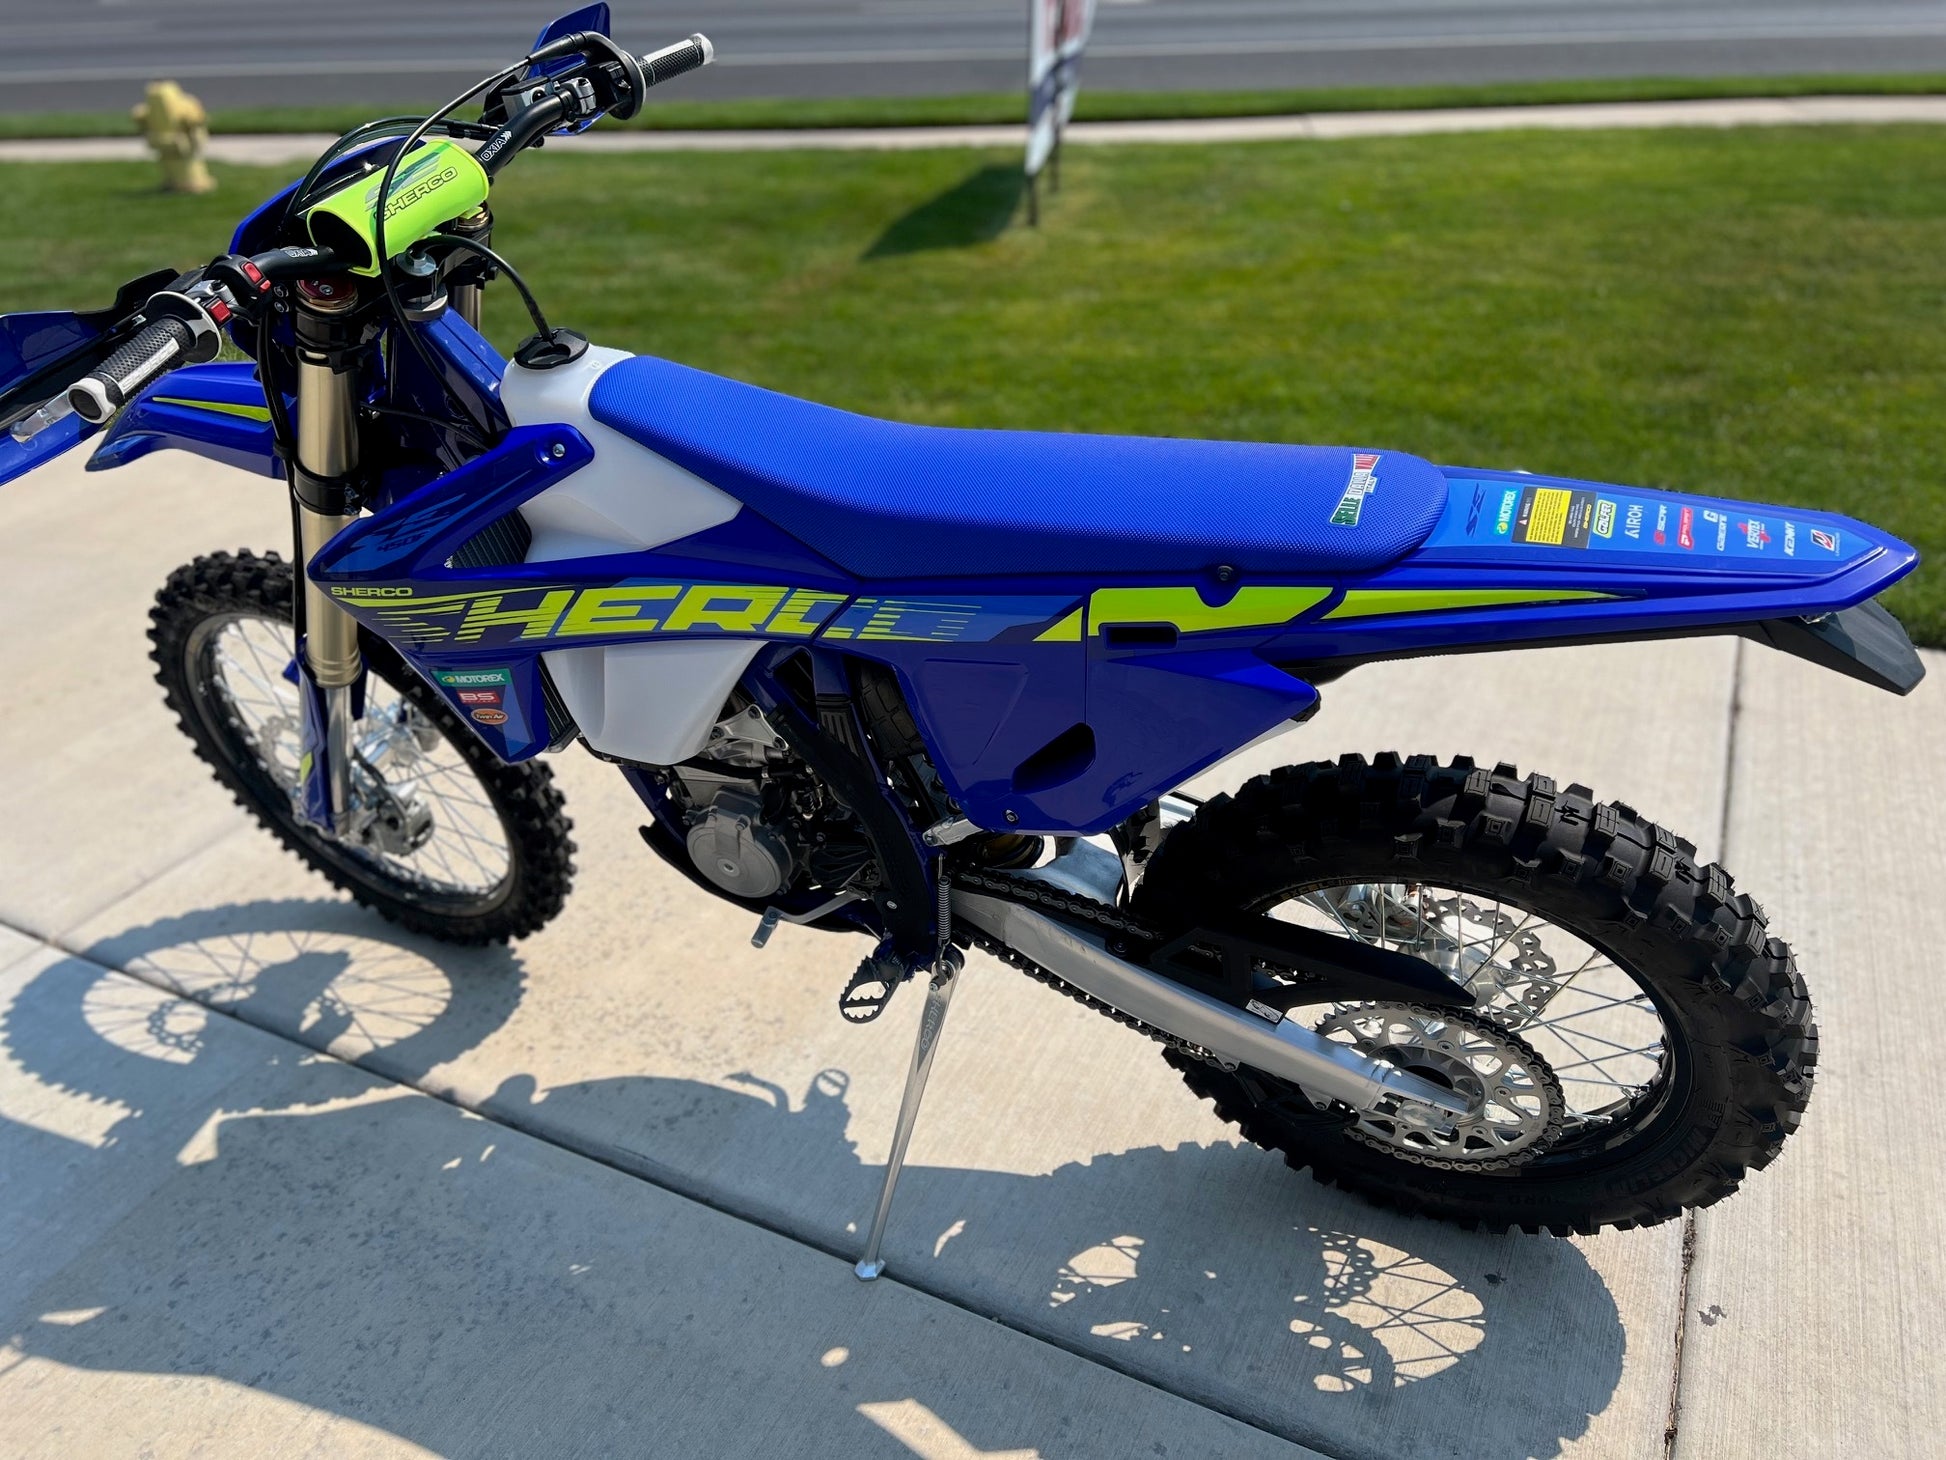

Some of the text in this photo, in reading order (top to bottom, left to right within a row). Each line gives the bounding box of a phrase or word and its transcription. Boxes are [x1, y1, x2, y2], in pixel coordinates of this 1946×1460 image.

[480, 138, 507, 161] OXIA
[1498, 490, 1517, 522] MOTOREX
[1624, 504, 1643, 539] AIROH
[1746, 519, 1760, 549] VERTEX
[1784, 521, 1795, 556] KENNY
[331, 586, 413, 597] SHERCO
[343, 584, 983, 645] SHERCO
[455, 674, 505, 683] MOTOREX
[459, 692, 495, 701] BS
